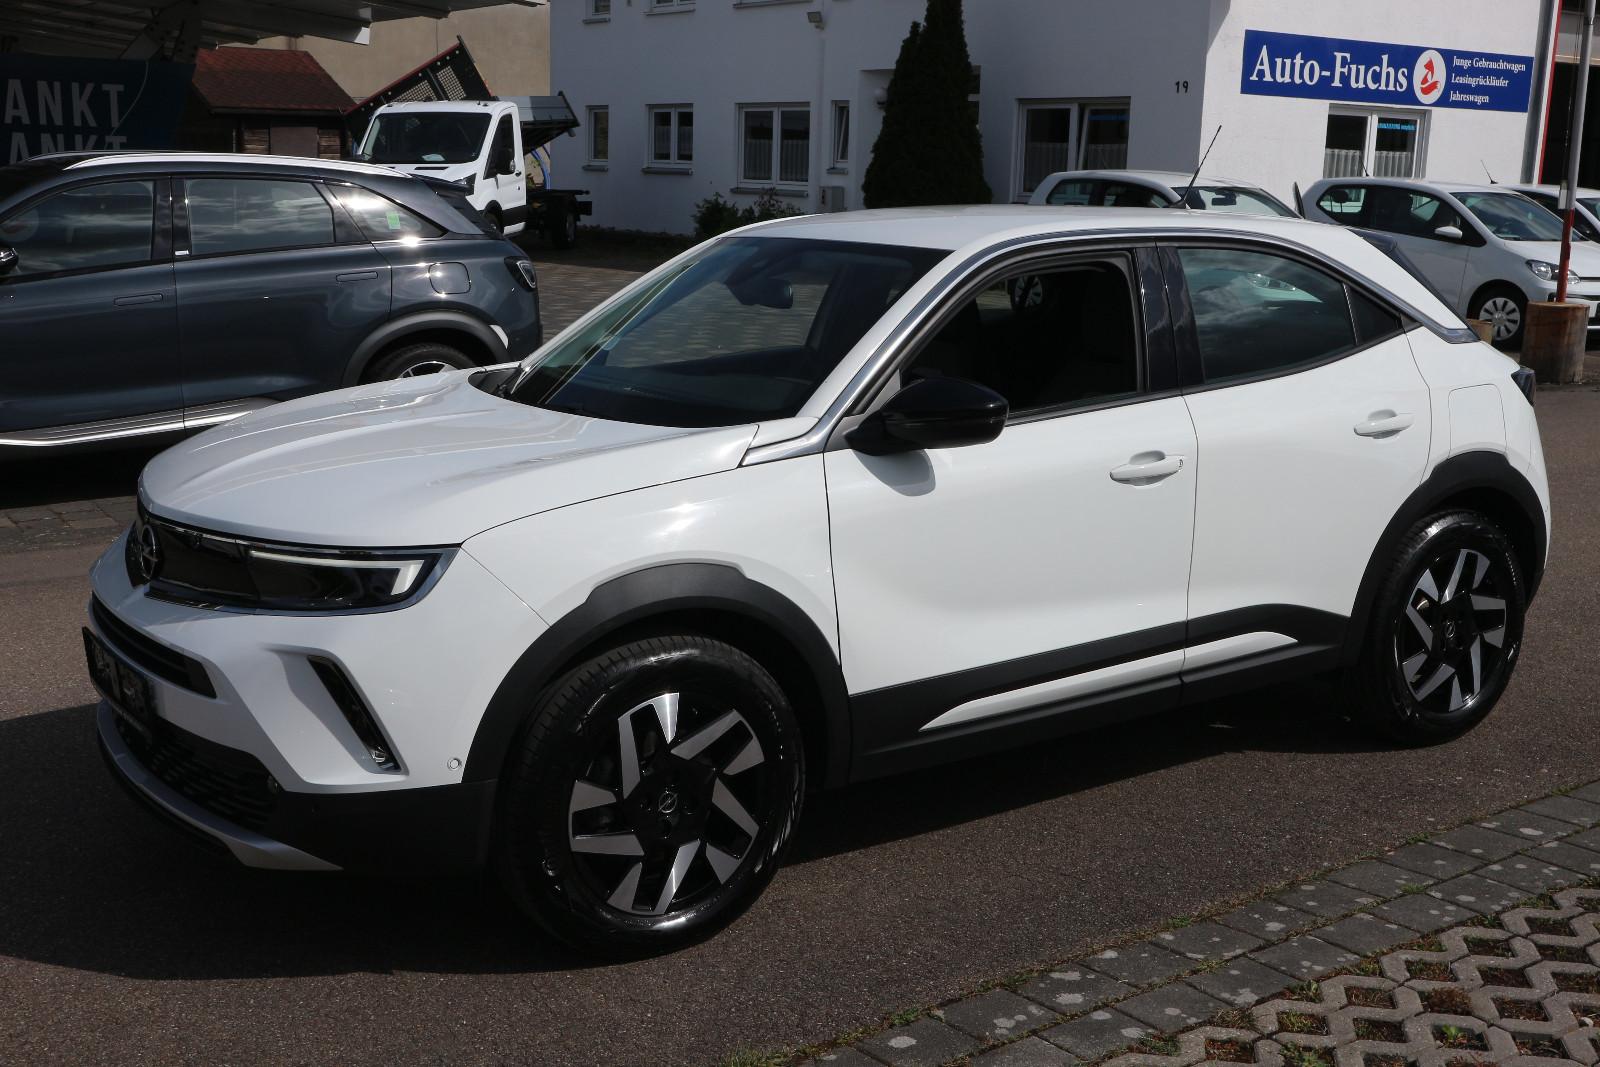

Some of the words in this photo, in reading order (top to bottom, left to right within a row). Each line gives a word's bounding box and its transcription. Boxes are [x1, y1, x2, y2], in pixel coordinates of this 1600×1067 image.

[1249, 44, 1408, 92] Auto-Fuchs
[1453, 56, 1472, 69] Junge
[1473, 57, 1526, 73] Gebrauchtwagen
[1175, 80, 1189, 94] 19
[1451, 73, 1509, 87] Leasingrückläufer
[4, 78, 125, 128] ANKT
[1449, 91, 1489, 105] Jahreswagen
